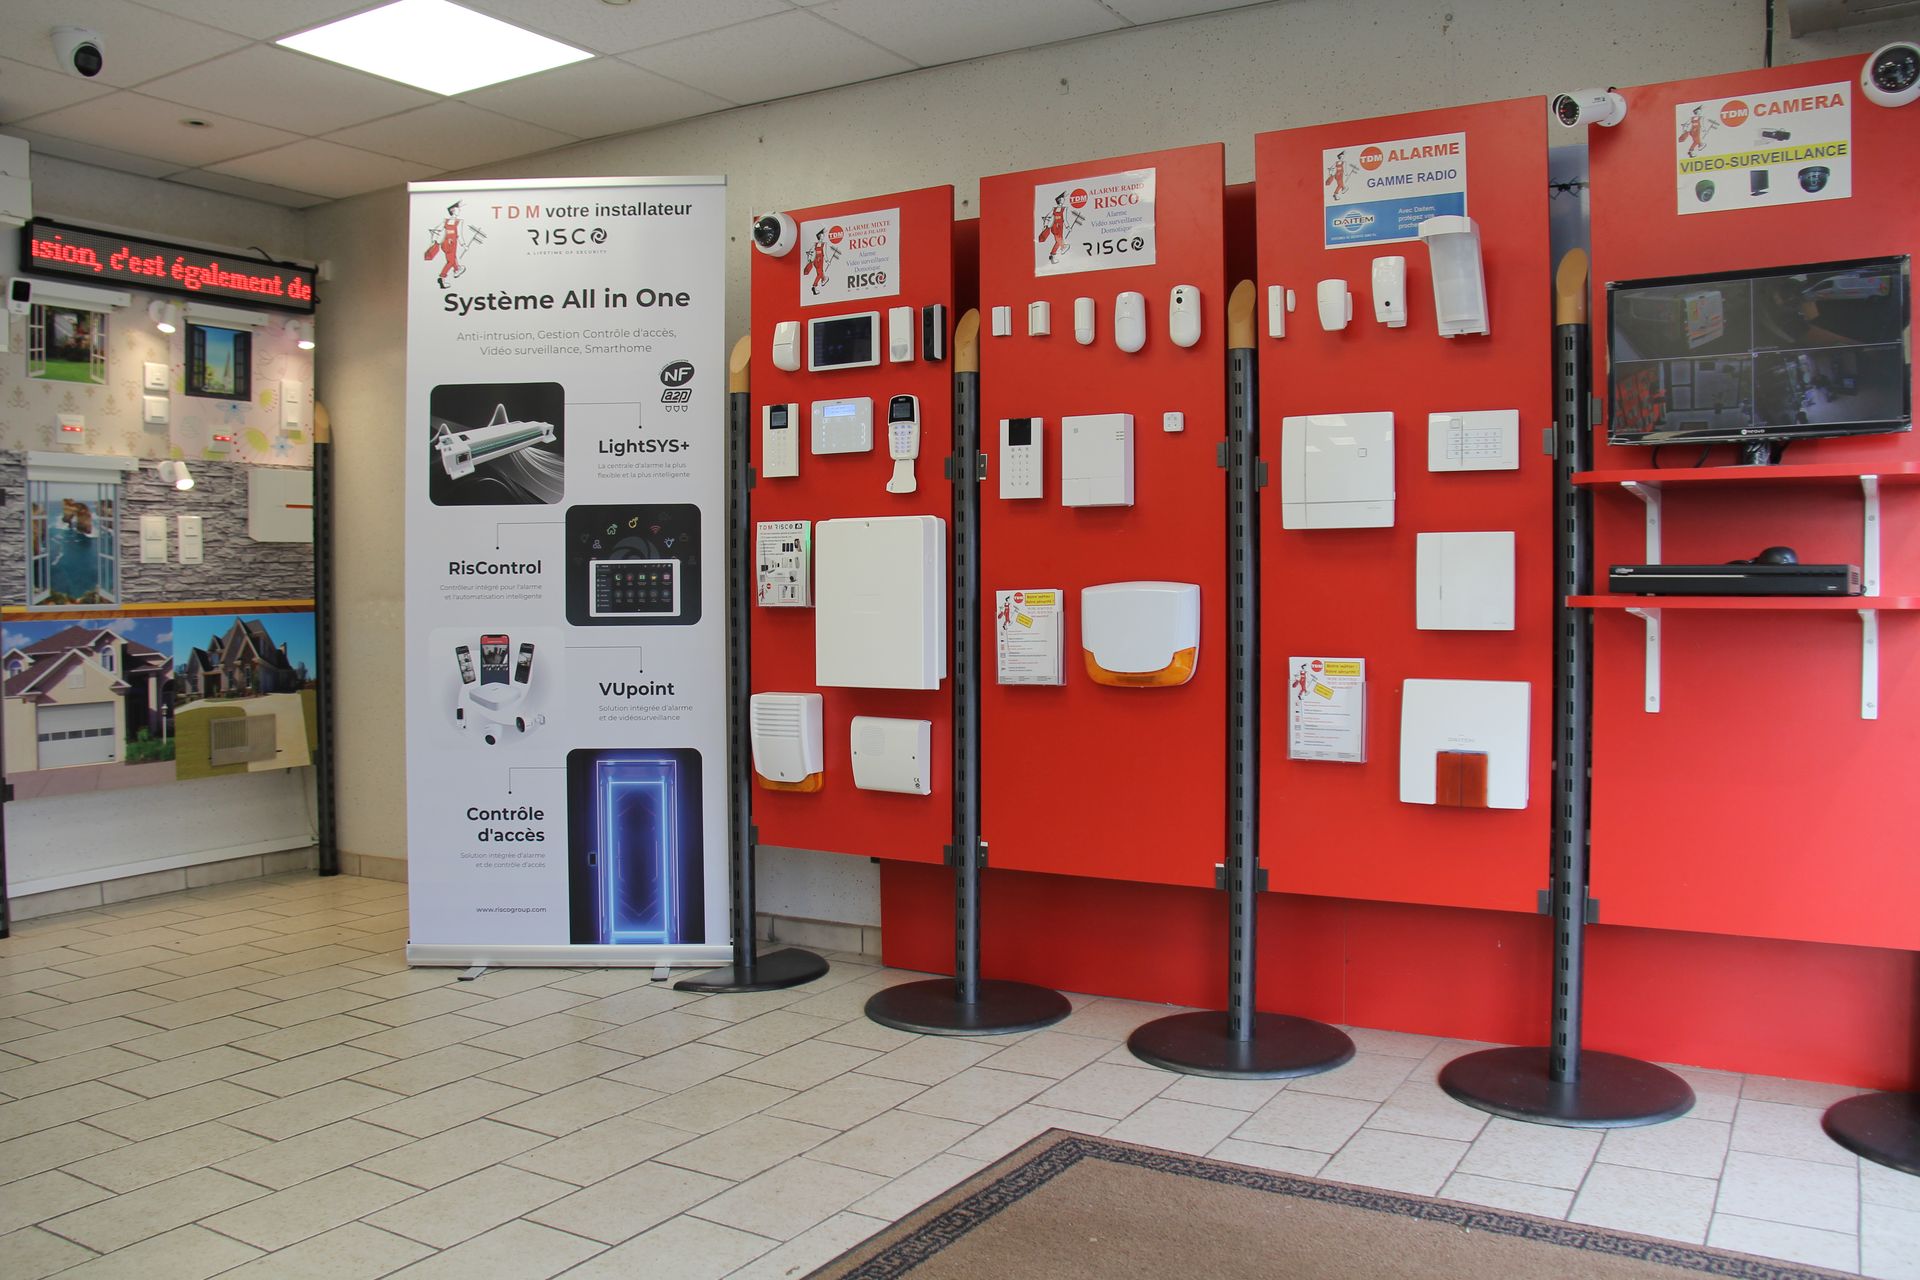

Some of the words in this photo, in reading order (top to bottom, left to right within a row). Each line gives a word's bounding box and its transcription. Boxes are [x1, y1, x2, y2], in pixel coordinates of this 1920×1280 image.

[1720, 109, 1748, 120] TDM
[1753, 93, 1844, 117] CAMERA
[1360, 153, 1383, 164] TDM
[1388, 142, 1460, 162] ALARME
[1680, 143, 1848, 173] VIDEO-SURVEILLANCE
[1367, 173, 1413, 188] GAMME
[1417, 169, 1457, 183] RADIO
[1069, 195, 1088, 203] TDM
[1089, 186, 1120, 197] ALARME
[1120, 182, 1145, 192] RADIO
[546, 203, 590, 218] votre
[595, 202, 693, 217] installateur
[1094, 193, 1139, 210] RISCO
[871, 220, 891, 228] MIXTE
[1333, 215, 1374, 226] DAITEM
[527, 227, 608, 246] RISCO
[849, 234, 887, 250] RISCO
[1082, 236, 1145, 257] RISCO
[110, 247, 167, 277] c'est
[170, 256, 284, 297] également
[287, 277, 312, 300] de
[847, 271, 888, 289] RISCO
[444, 290, 554, 316] Système
[562, 289, 596, 309] All
[604, 287, 628, 309] in
[636, 288, 691, 308] One
[456, 330, 536, 342] Anti-intrusion,
[537, 329, 580, 340] Gestion
[582, 328, 631, 340] Contrôle
[632, 328, 678, 339] d'accès,
[479, 346, 512, 356] Vidéo
[514, 344, 583, 356] surveillance,
[584, 343, 653, 355] Smarthome
[664, 366, 692, 382] NF
[598, 438, 690, 457] LightSYS+
[449, 560, 542, 575] RisControl
[598, 680, 676, 699] VUpoint
[466, 806, 545, 821] Contrôle
[477, 827, 545, 842] d'accès
[476, 906, 547, 914] www.riscogroup.com
